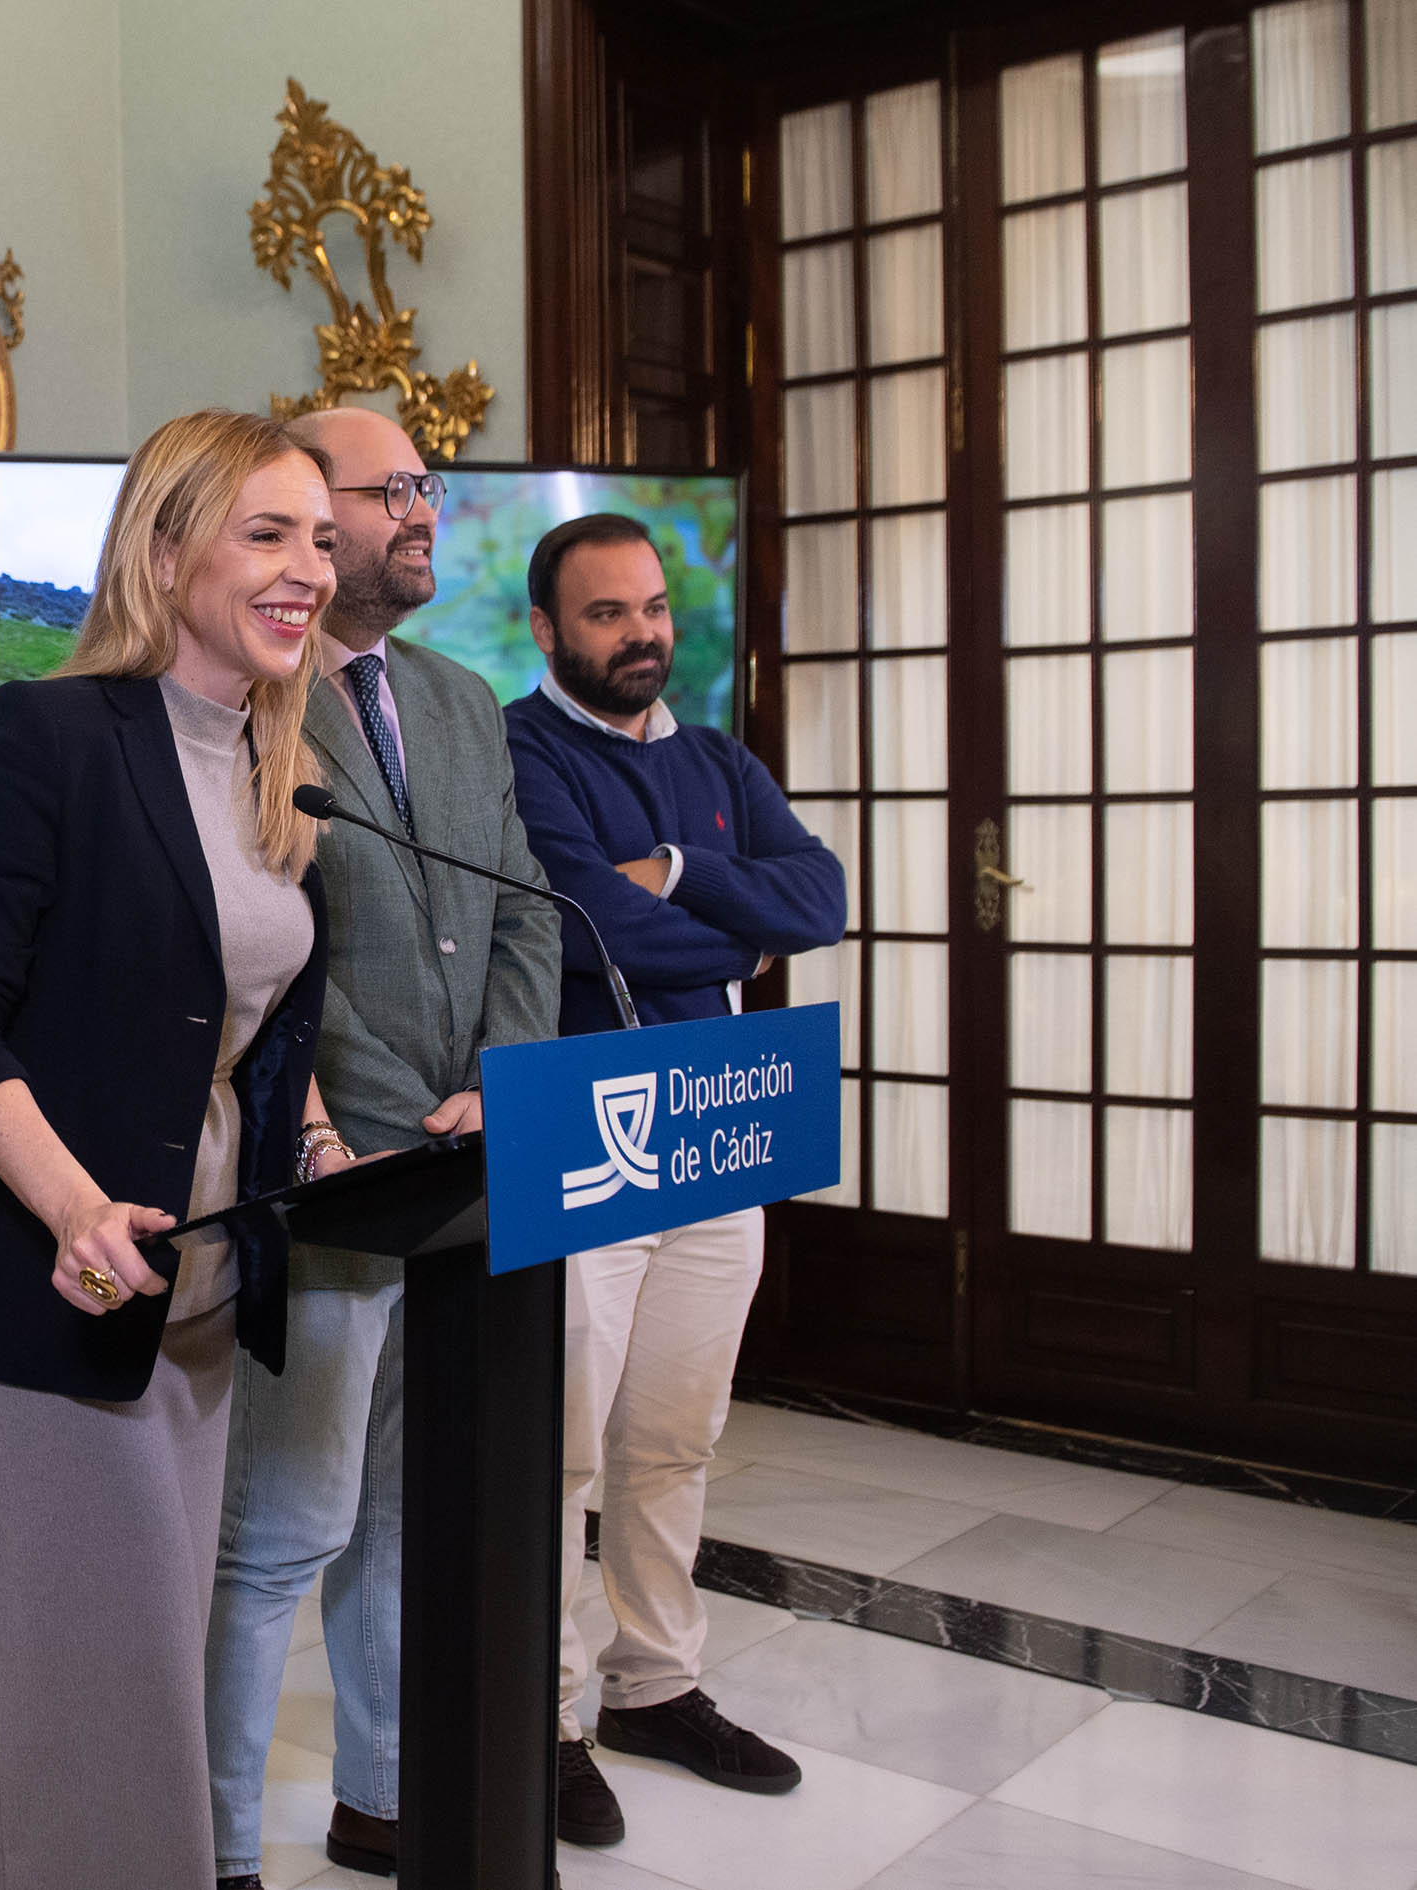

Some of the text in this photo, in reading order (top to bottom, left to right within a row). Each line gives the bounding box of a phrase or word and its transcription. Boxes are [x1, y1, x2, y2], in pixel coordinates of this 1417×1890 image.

[669, 1053, 793, 1119] Diputación
[670, 1122, 773, 1185] de Cádiz
